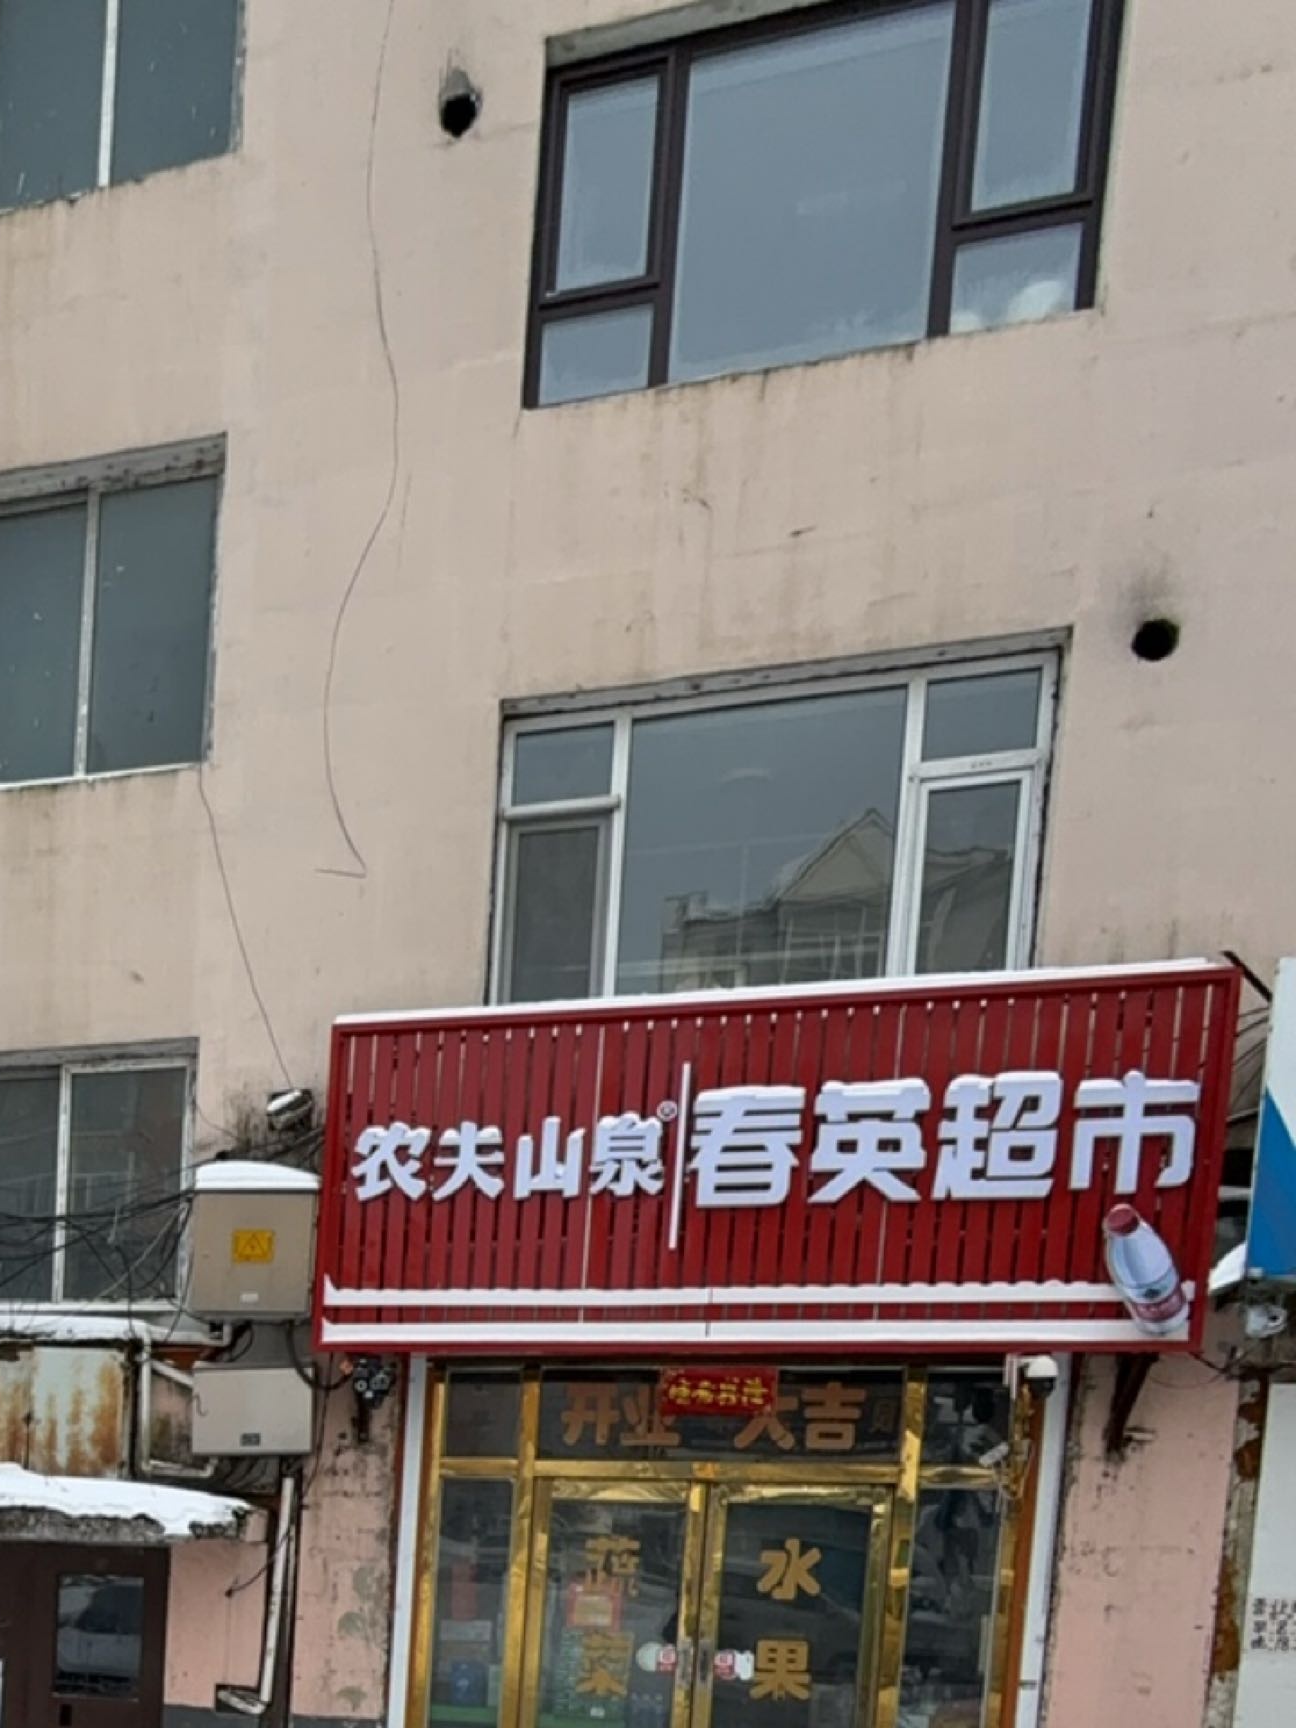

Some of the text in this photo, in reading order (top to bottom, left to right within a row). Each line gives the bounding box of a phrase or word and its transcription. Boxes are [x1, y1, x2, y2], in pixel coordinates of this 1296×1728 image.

[350, 1070, 1202, 1211] 农夫山泉 春英超市
[749, 1538, 822, 1700] 水果
